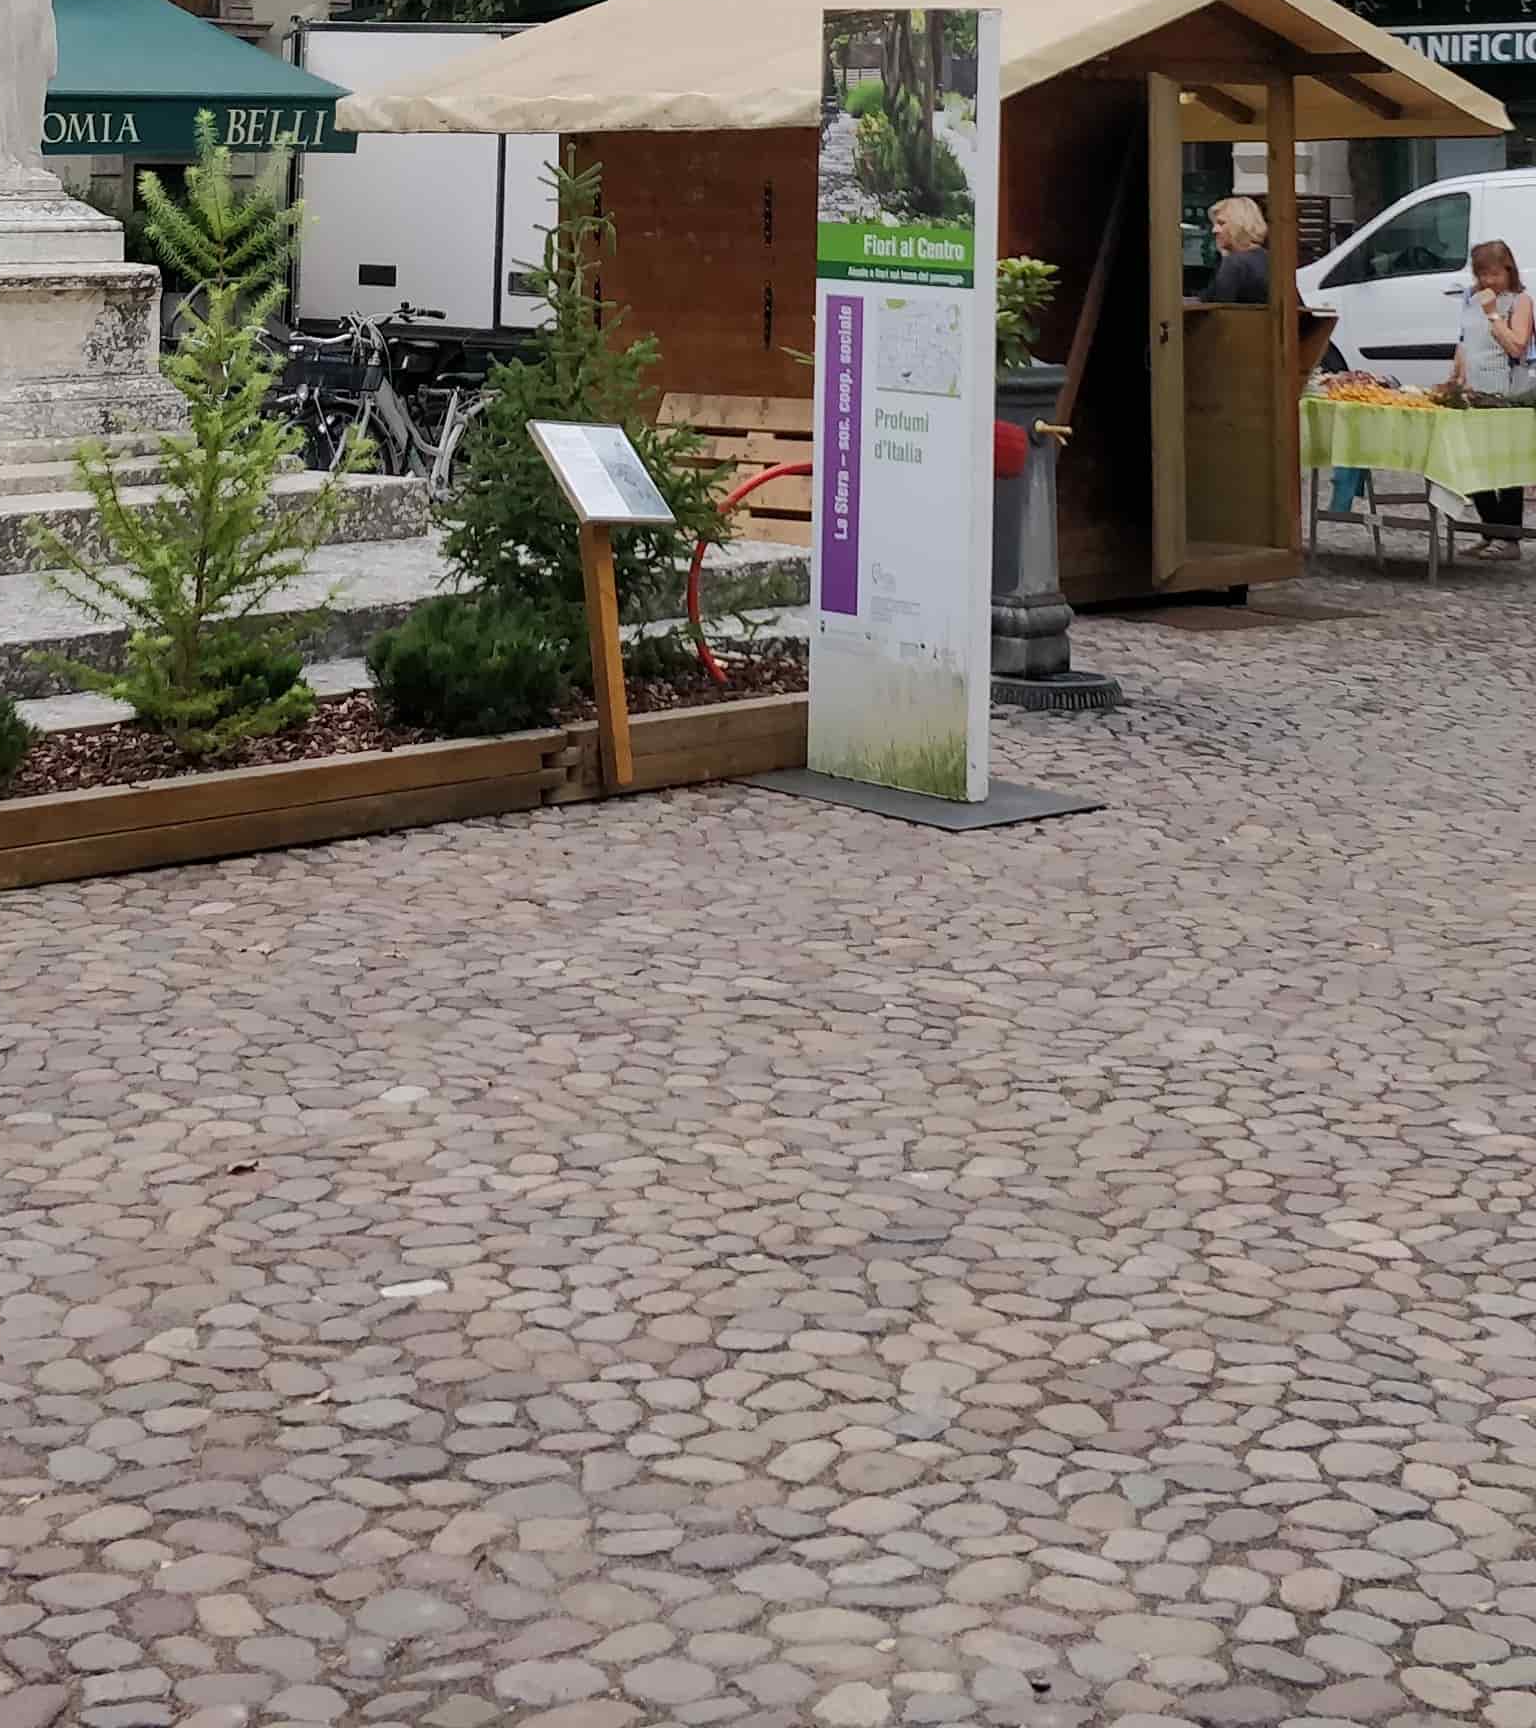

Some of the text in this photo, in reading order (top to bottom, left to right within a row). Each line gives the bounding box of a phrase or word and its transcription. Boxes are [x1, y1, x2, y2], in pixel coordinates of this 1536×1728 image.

[40, 112, 141, 144] OMIA
[225, 108, 329, 147] BELLI
[864, 234, 965, 261] Fiori al Centro
[874, 407, 929, 433] Profumi
[874, 440, 922, 464] d'Italia
